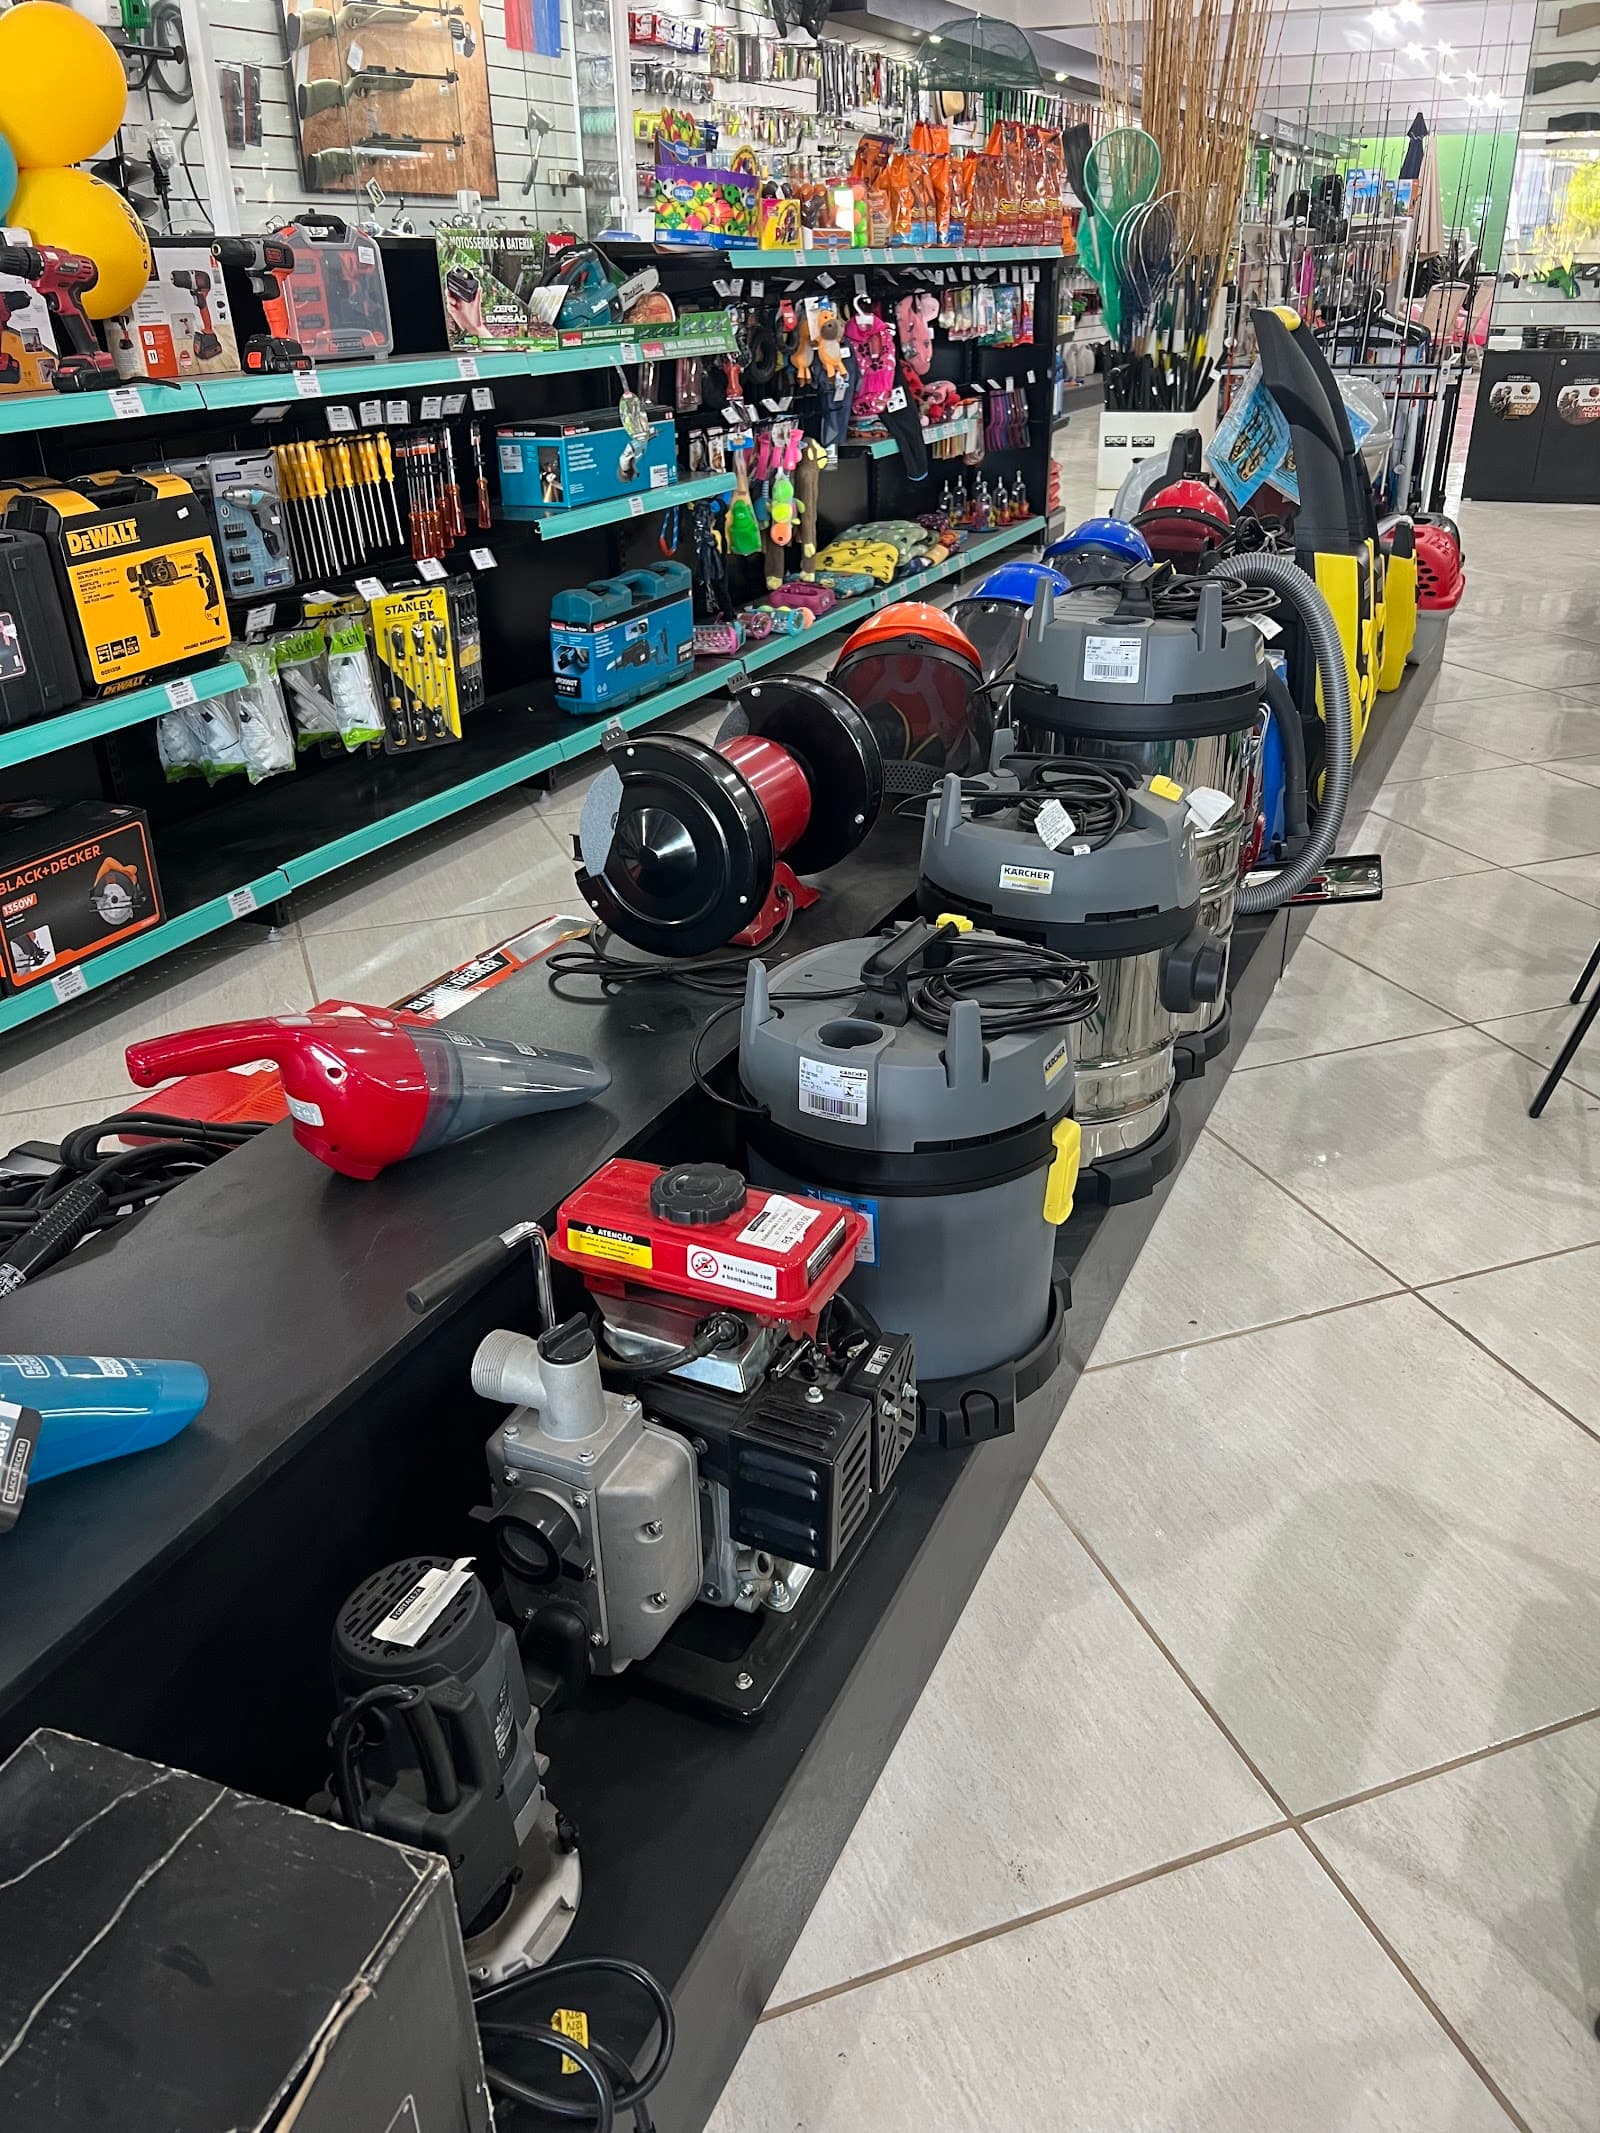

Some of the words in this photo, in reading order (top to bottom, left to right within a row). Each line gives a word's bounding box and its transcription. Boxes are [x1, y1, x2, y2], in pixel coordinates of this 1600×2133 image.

[450, 236, 498, 250] MOTOSSERRAS
[507, 236, 535, 250] BATERIA
[493, 304, 519, 313] ZERO
[486, 313, 528, 324] EMISSÃO
[384, 600, 434, 616] STANLEY
[0, 845, 102, 896] BLACK+DECKER
[3, 895, 35, 916] 1350W
[598, 1228, 634, 1243] ATENÇÃO
[726, 1275, 746, 1284] bomba
[6, 1441, 28, 1501] BLACK+DECKER
